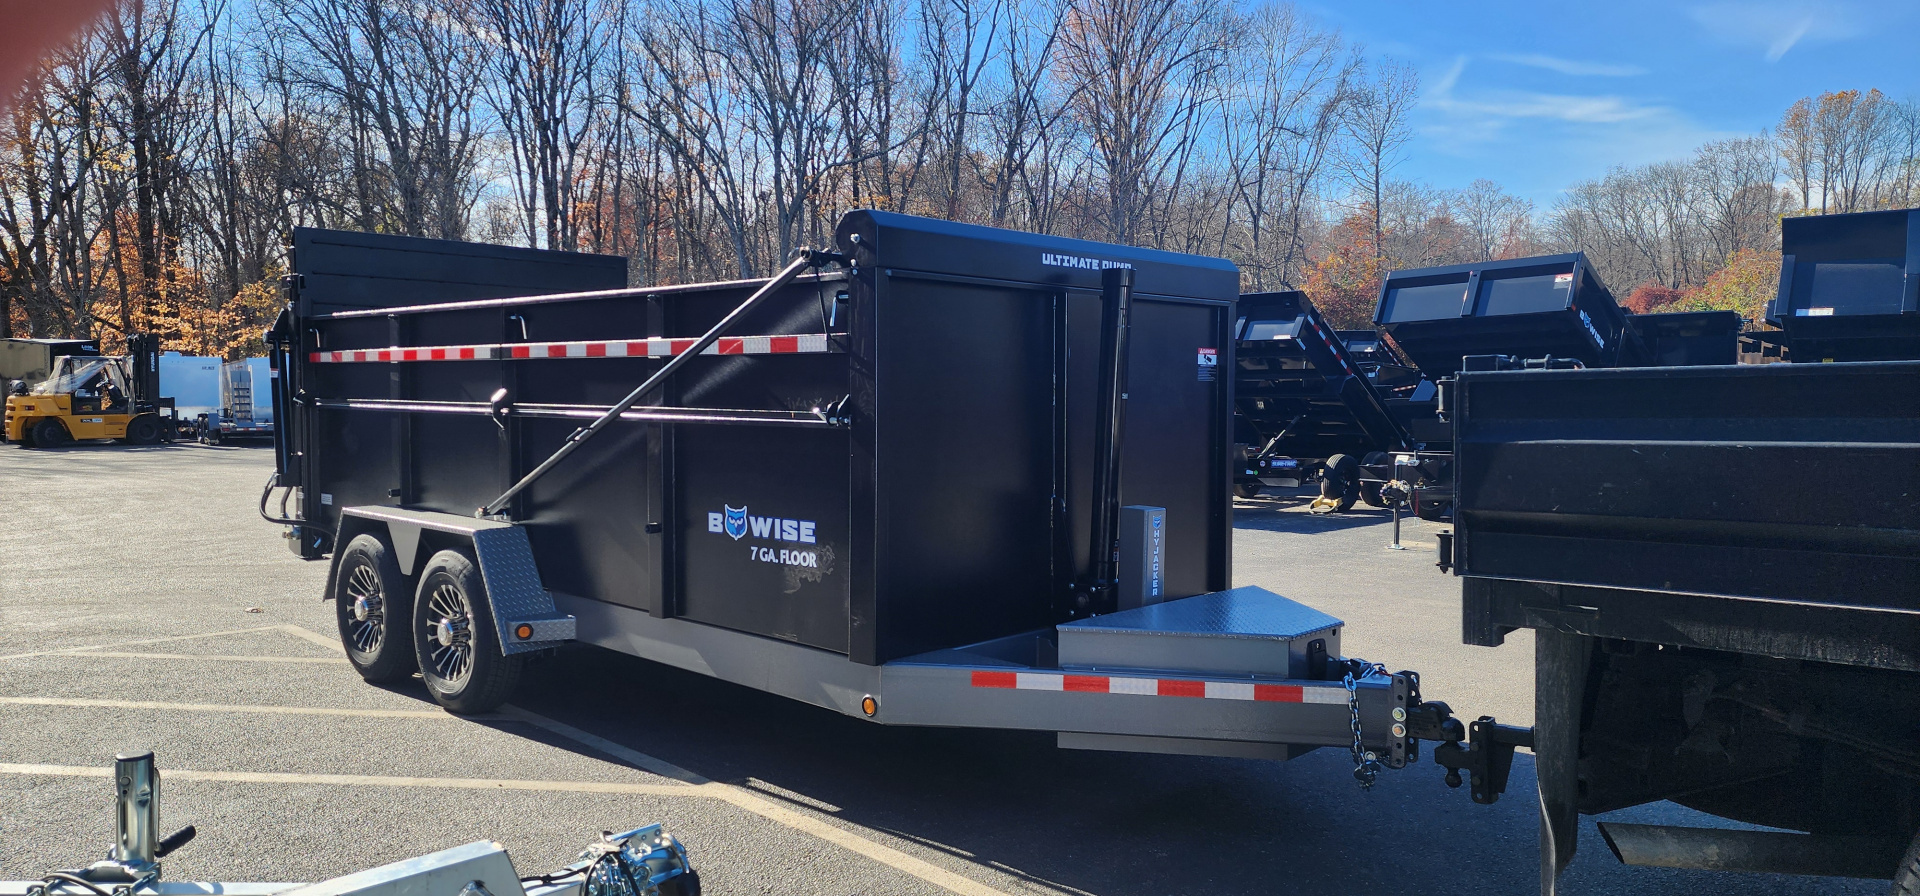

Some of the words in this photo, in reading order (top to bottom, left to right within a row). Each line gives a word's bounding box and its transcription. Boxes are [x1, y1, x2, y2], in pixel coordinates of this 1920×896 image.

[1042, 252, 1099, 270] ULTIMATE
[750, 546, 758, 561] 7
[759, 548, 779, 563] GA.
[780, 550, 817, 568] FLOOR
[1152, 530, 1160, 596] HYJACKER
